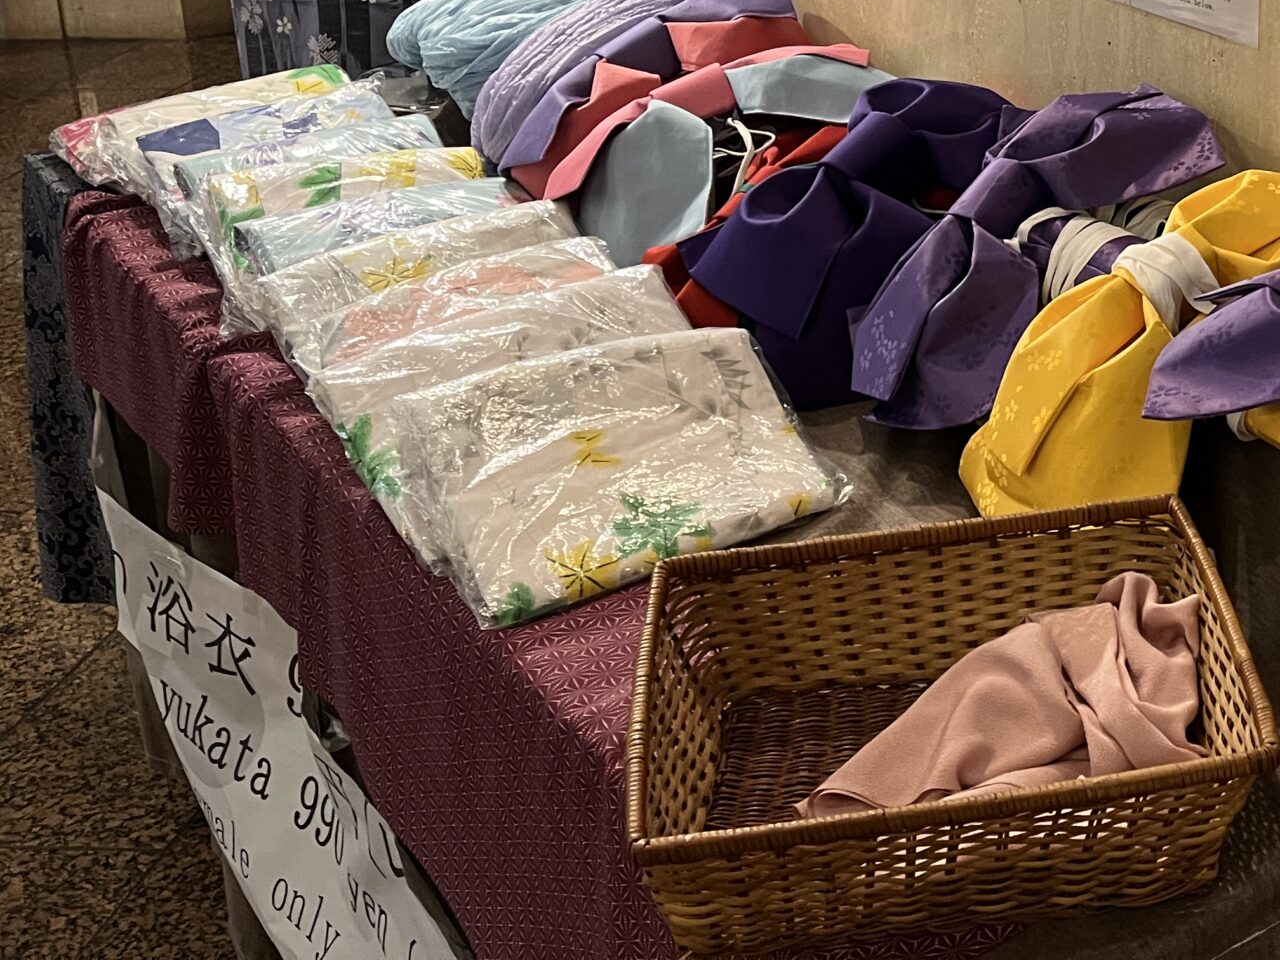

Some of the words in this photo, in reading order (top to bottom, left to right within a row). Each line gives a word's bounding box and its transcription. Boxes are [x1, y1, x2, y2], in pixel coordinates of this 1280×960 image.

[147, 561, 256, 696] 浴衣
[160, 679, 272, 800] yukata
[347, 872, 388, 957] yen
[198, 797, 250, 879] male
[270, 878, 341, 960] only
